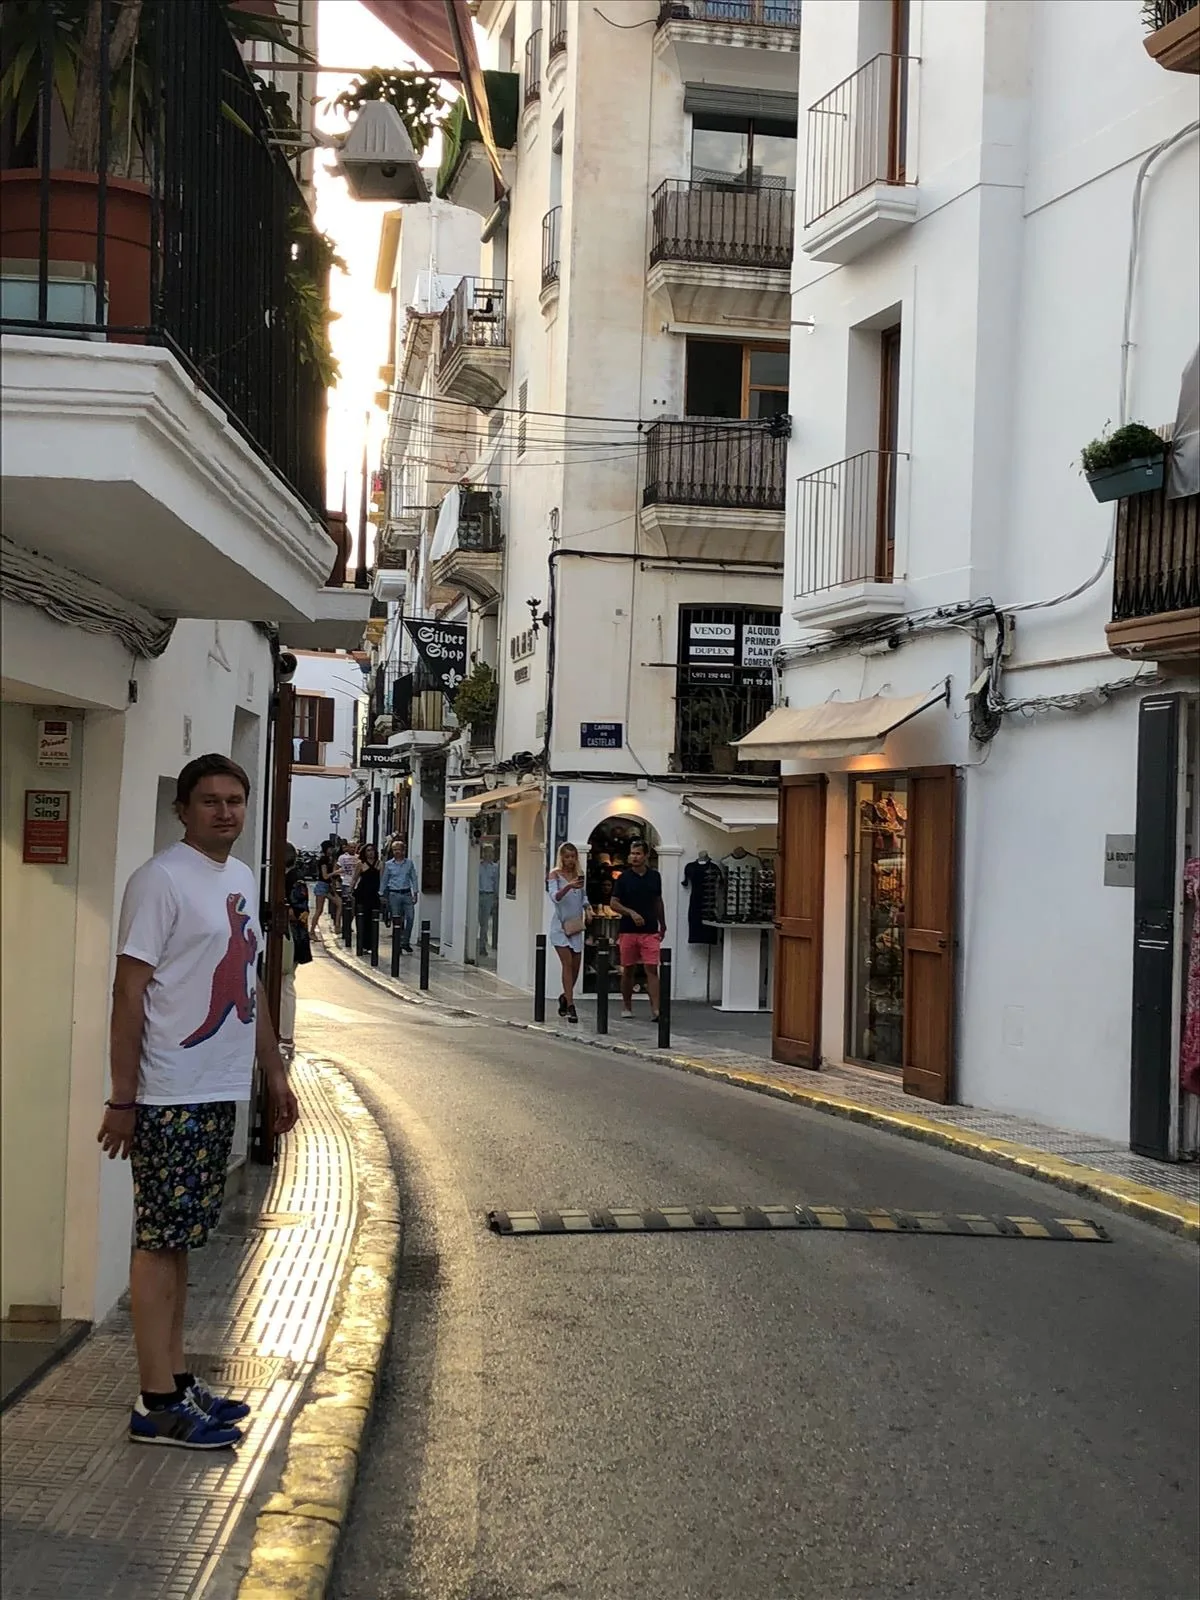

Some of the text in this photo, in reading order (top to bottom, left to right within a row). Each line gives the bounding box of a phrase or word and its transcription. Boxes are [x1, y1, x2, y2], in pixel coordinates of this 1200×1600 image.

[417, 626, 465, 645] Silver
[694, 627, 732, 635] VENDO
[747, 626, 780, 636] ALQUILO
[425, 642, 464, 662] Shop
[695, 647, 729, 655] DUPLEX
[747, 647, 773, 656] PLANT
[743, 658, 774, 666] COMERC
[34, 793, 61, 807] Sing
[34, 807, 61, 820] Sing
